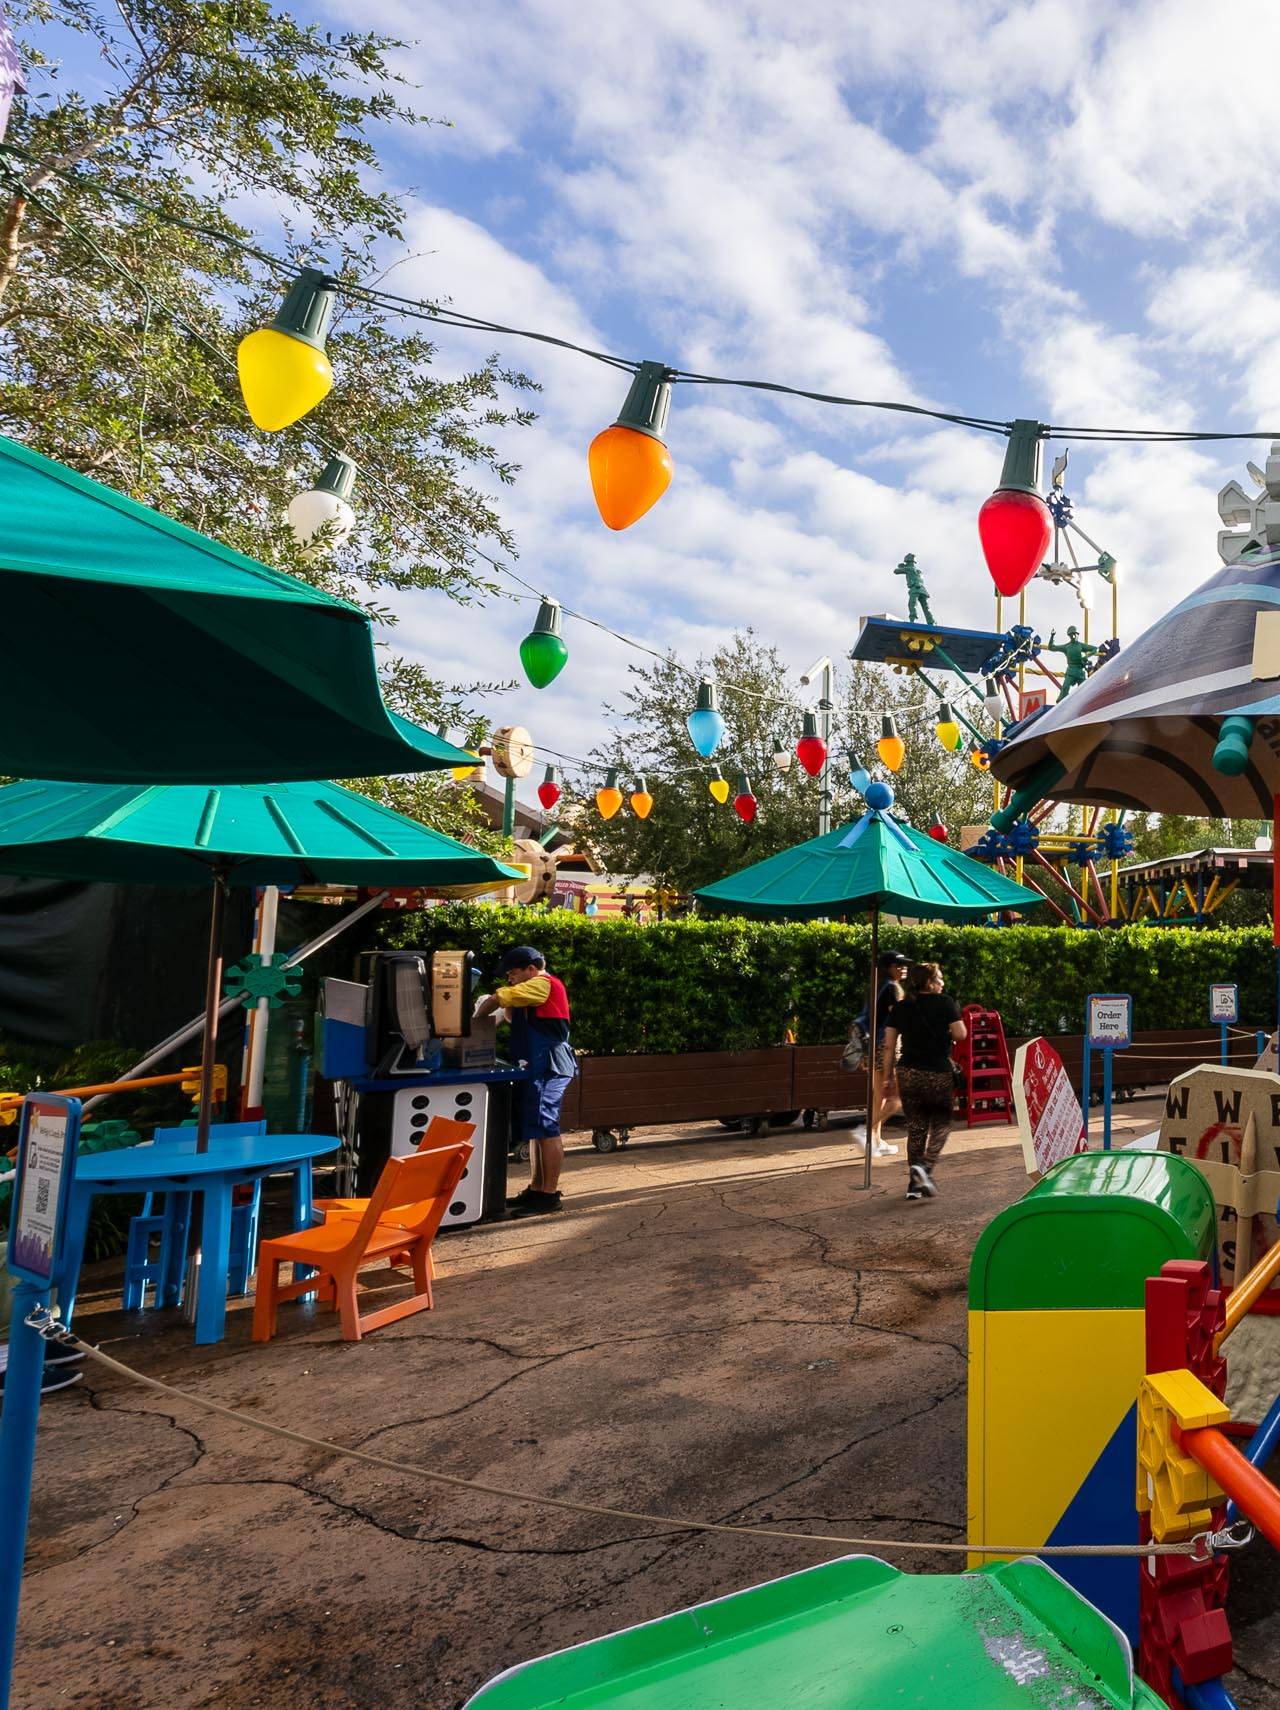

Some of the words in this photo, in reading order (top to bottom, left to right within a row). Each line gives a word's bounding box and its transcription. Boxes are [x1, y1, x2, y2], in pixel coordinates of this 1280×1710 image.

[1097, 1011, 1122, 1019] Order
[1099, 1022, 1119, 1030] Here
[1166, 1087, 1190, 1119] W
[1214, 1090, 1243, 1123] W
